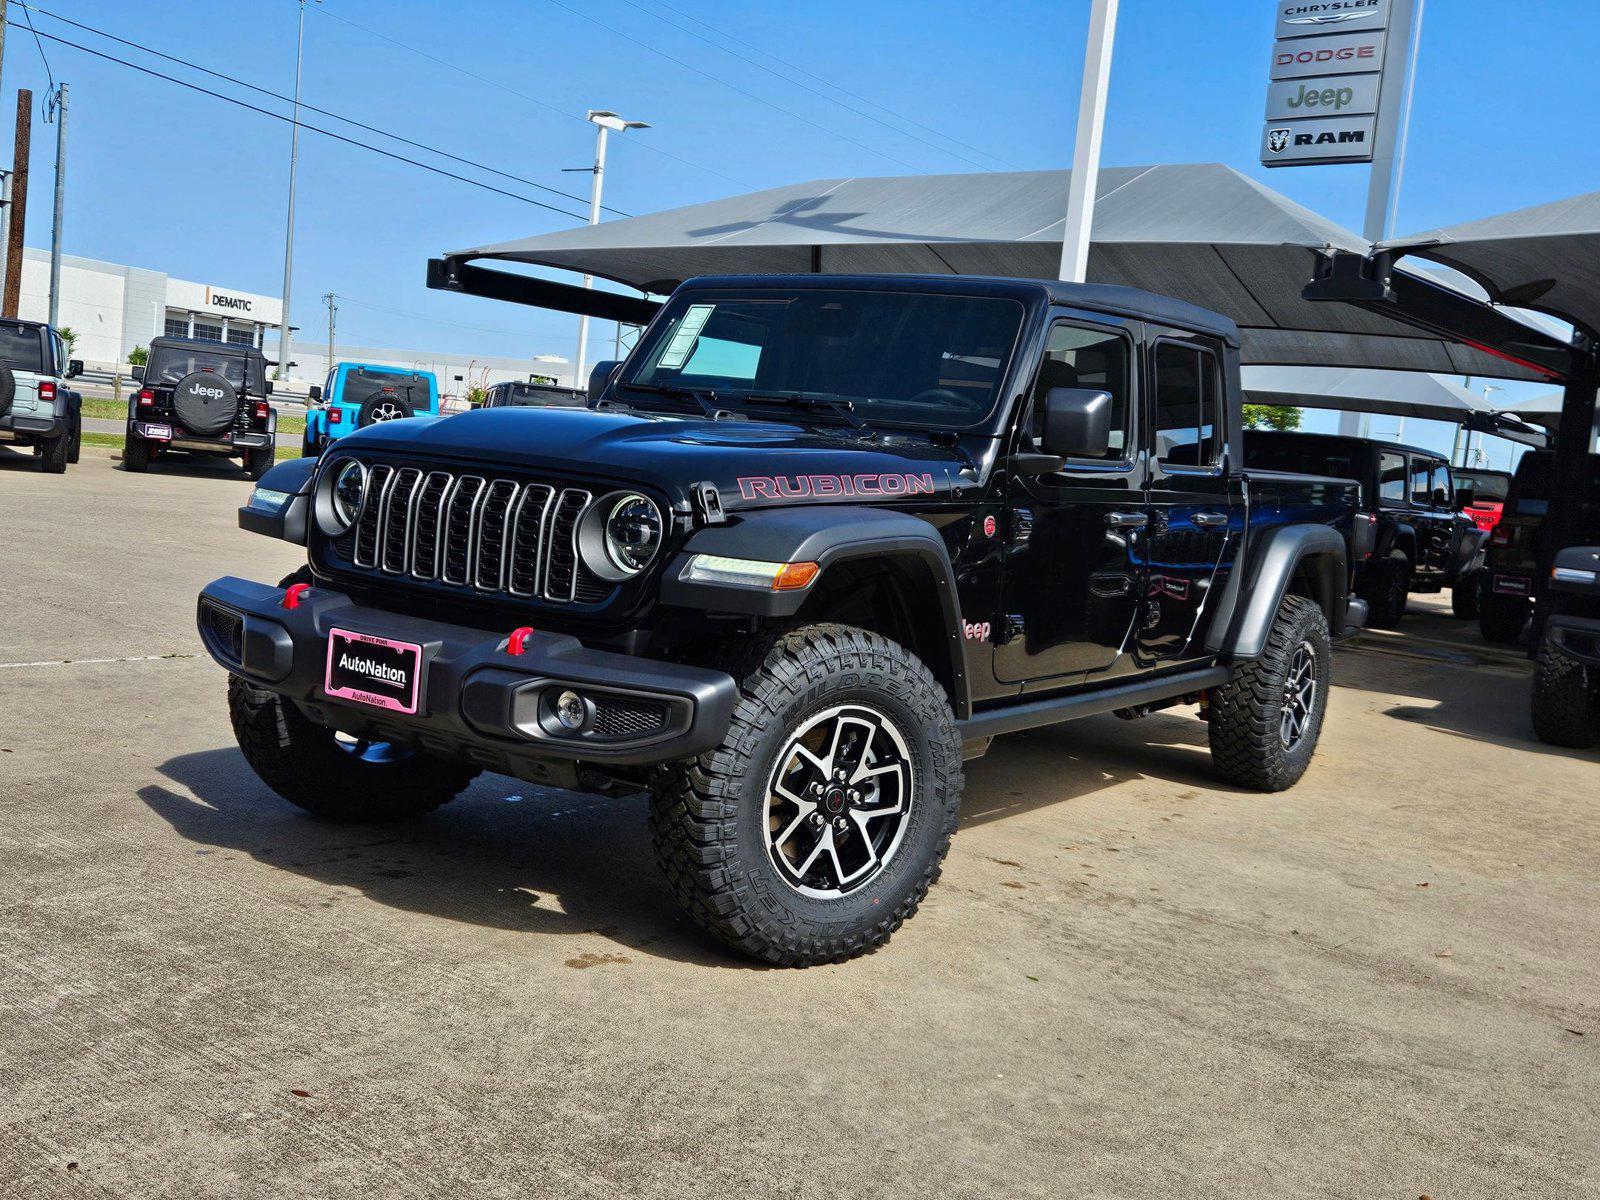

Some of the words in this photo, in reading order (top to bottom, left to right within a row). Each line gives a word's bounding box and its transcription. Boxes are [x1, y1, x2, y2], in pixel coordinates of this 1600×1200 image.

[1284, 0, 1378, 15] CHRYSLER
[1276, 46, 1375, 65] DODGE
[1287, 85, 1353, 110] Jeep
[1294, 131, 1365, 146] RAM
[212, 294, 252, 311] DEMATIC
[189, 383, 224, 400] Jeep
[737, 474, 934, 499] RUBICON
